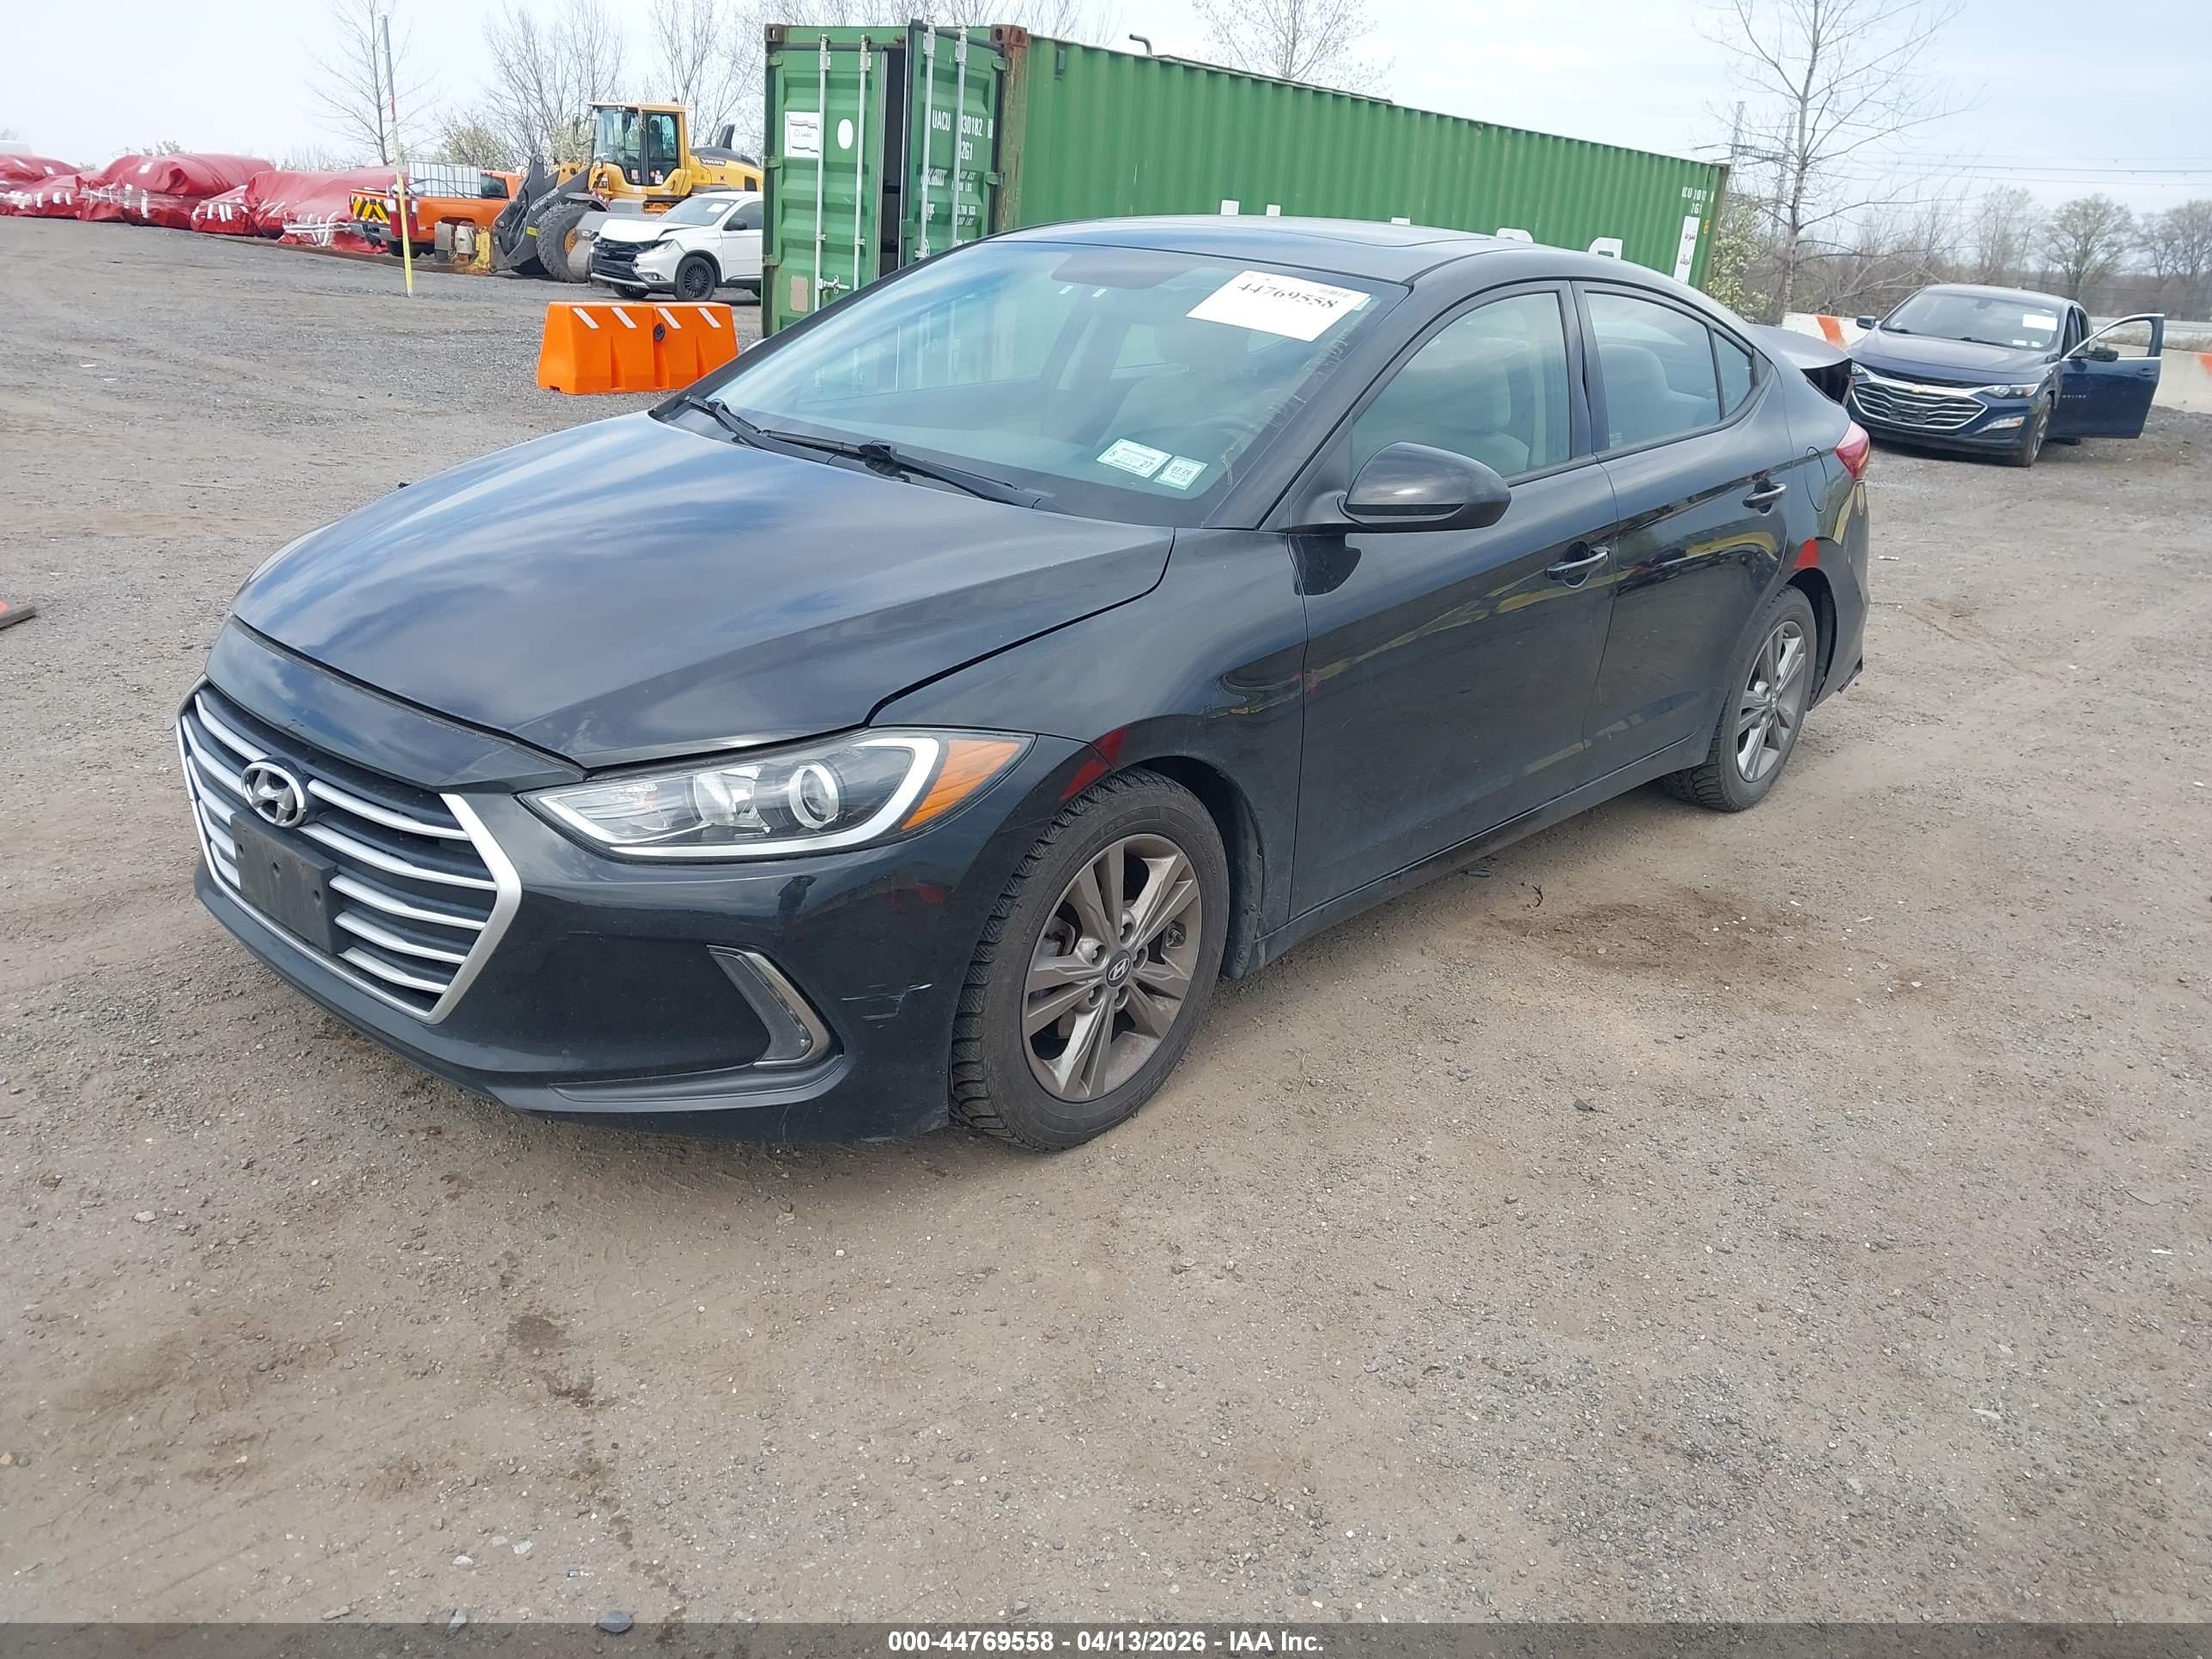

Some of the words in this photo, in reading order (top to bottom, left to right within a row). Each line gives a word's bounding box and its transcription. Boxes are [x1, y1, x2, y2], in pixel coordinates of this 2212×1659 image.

[932, 109, 951, 131] UACU
[961, 113, 983, 137] 30182
[1237, 283, 1339, 308] 44769558
[1139, 460, 1155, 469] 27
